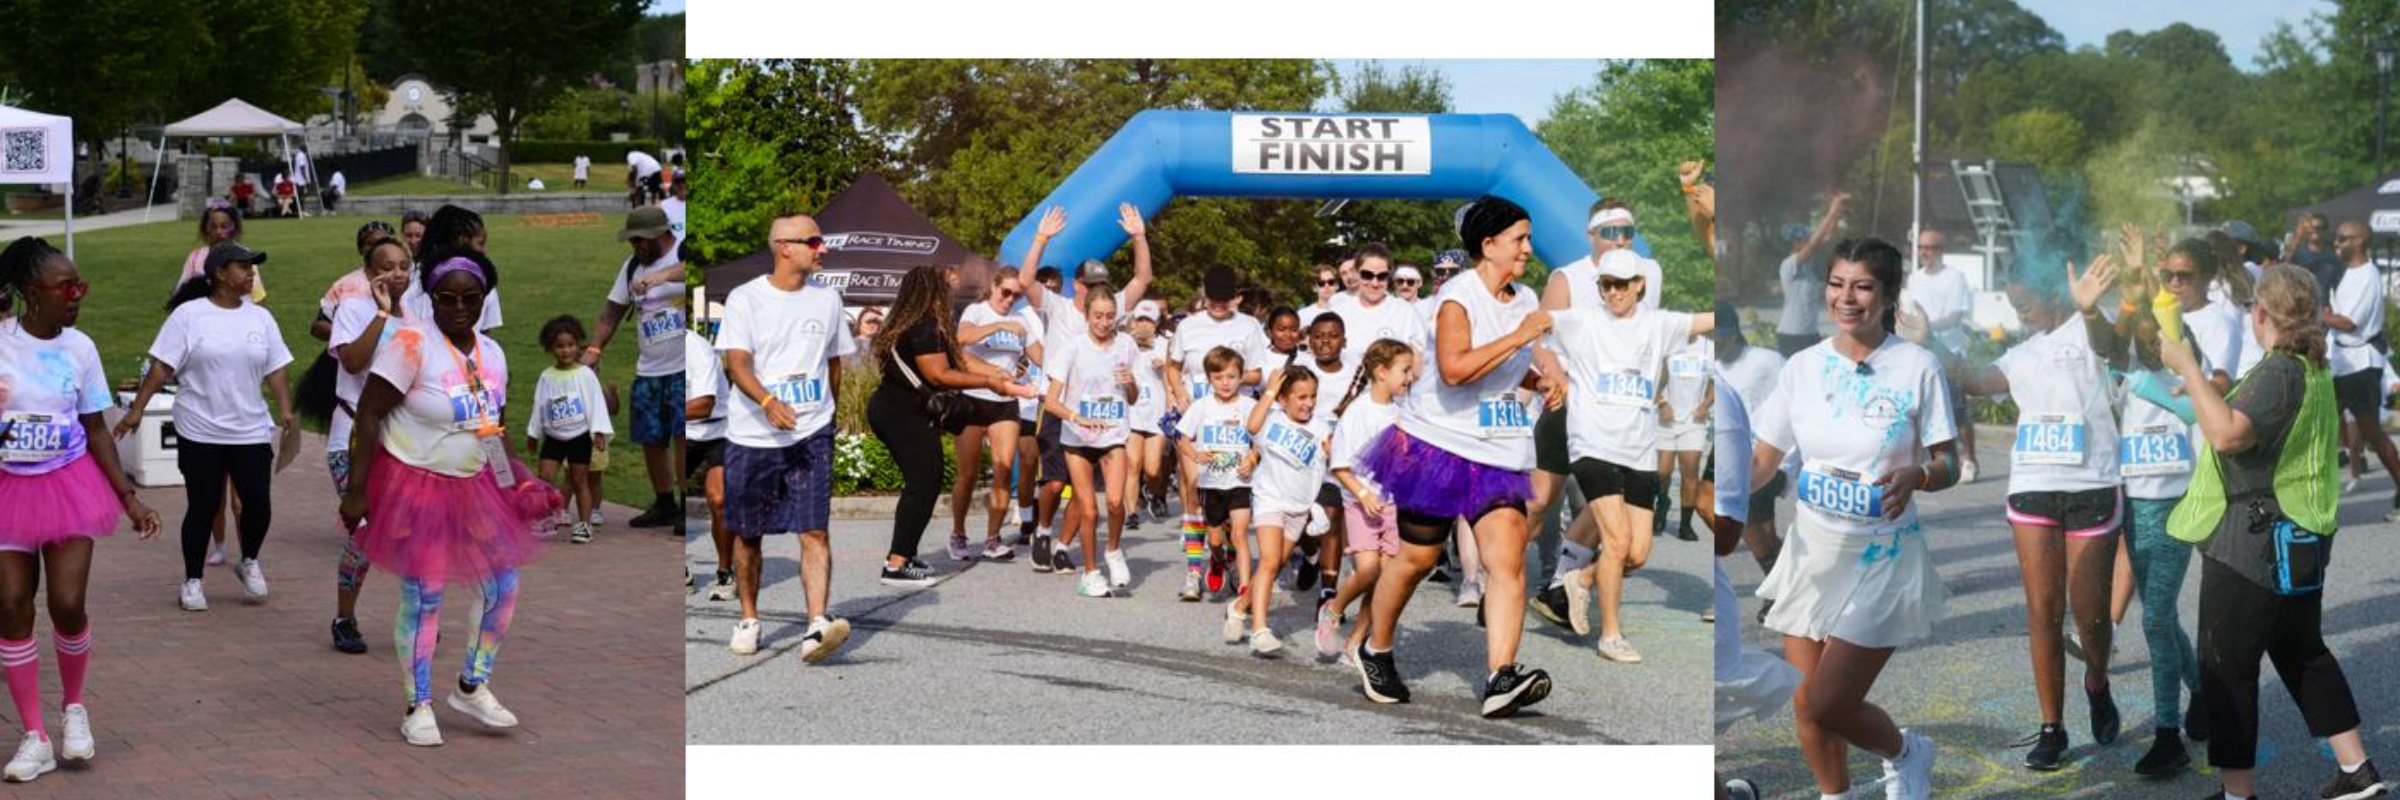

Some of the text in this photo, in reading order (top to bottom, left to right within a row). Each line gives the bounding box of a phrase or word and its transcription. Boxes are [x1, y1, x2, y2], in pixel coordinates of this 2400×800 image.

[1261, 117, 1400, 139] START
[1259, 142, 1404, 172] FINISH
[848, 235, 882, 245] RACE
[887, 237, 933, 249] TIMING
[850, 273, 880, 287] RACE
[775, 379, 816, 403] 1410
[1607, 372, 1646, 399] 1344
[1086, 400, 1120, 419] 1449
[1211, 425, 1246, 444] 1452
[1277, 426, 1314, 462] 1346
[2024, 424, 2074, 451] 1464
[2127, 434, 2180, 464] 1433
[1807, 473, 1871, 516] 5699
